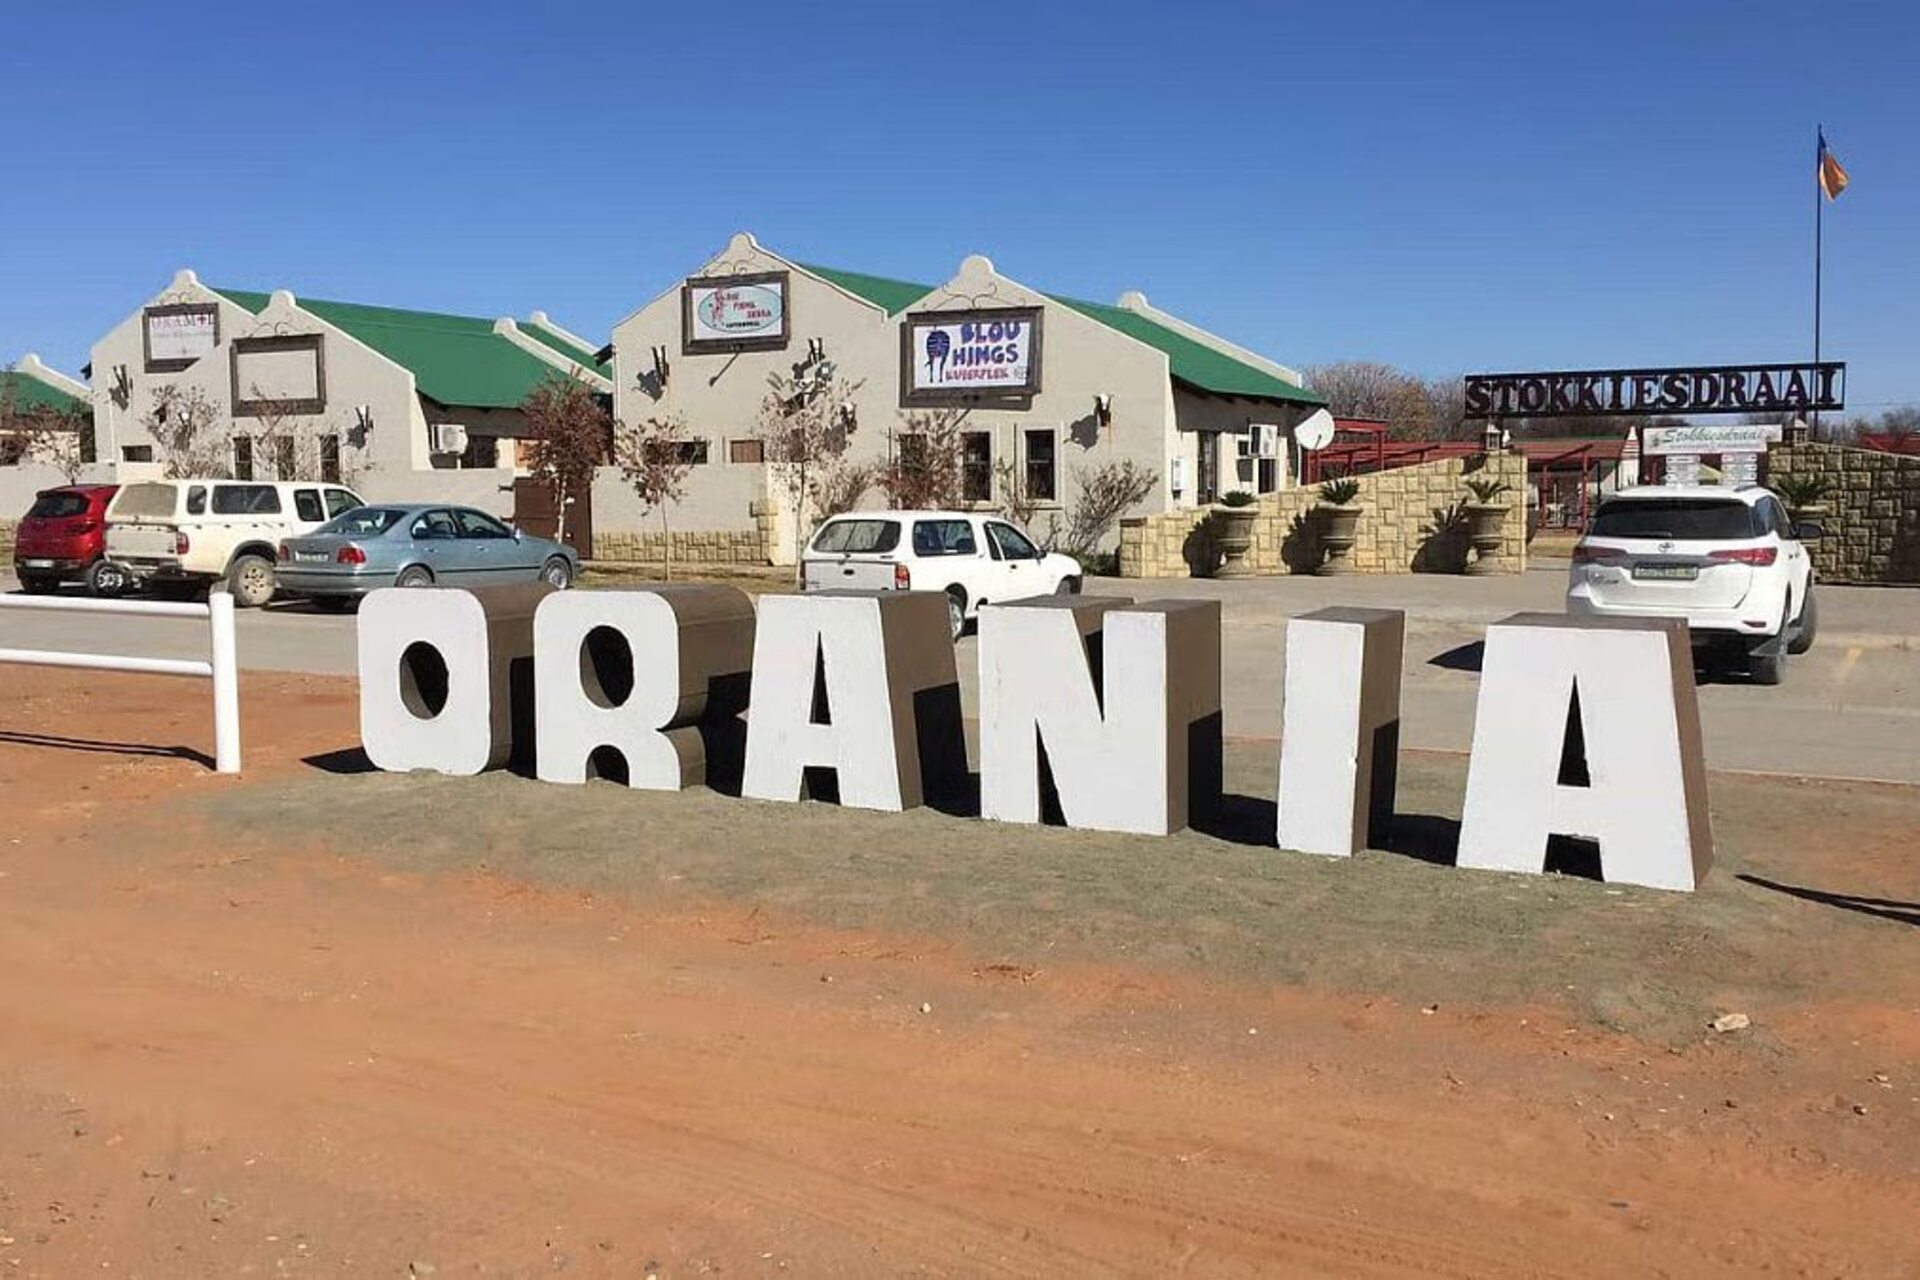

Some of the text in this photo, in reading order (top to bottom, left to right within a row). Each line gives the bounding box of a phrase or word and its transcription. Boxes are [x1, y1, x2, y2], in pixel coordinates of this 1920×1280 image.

[961, 321, 1020, 344] BLOU
[953, 344, 1019, 366] HINGS
[1465, 369, 1837, 414] STOKKIESDRAAI
[357, 587, 1696, 892] ORANIA
